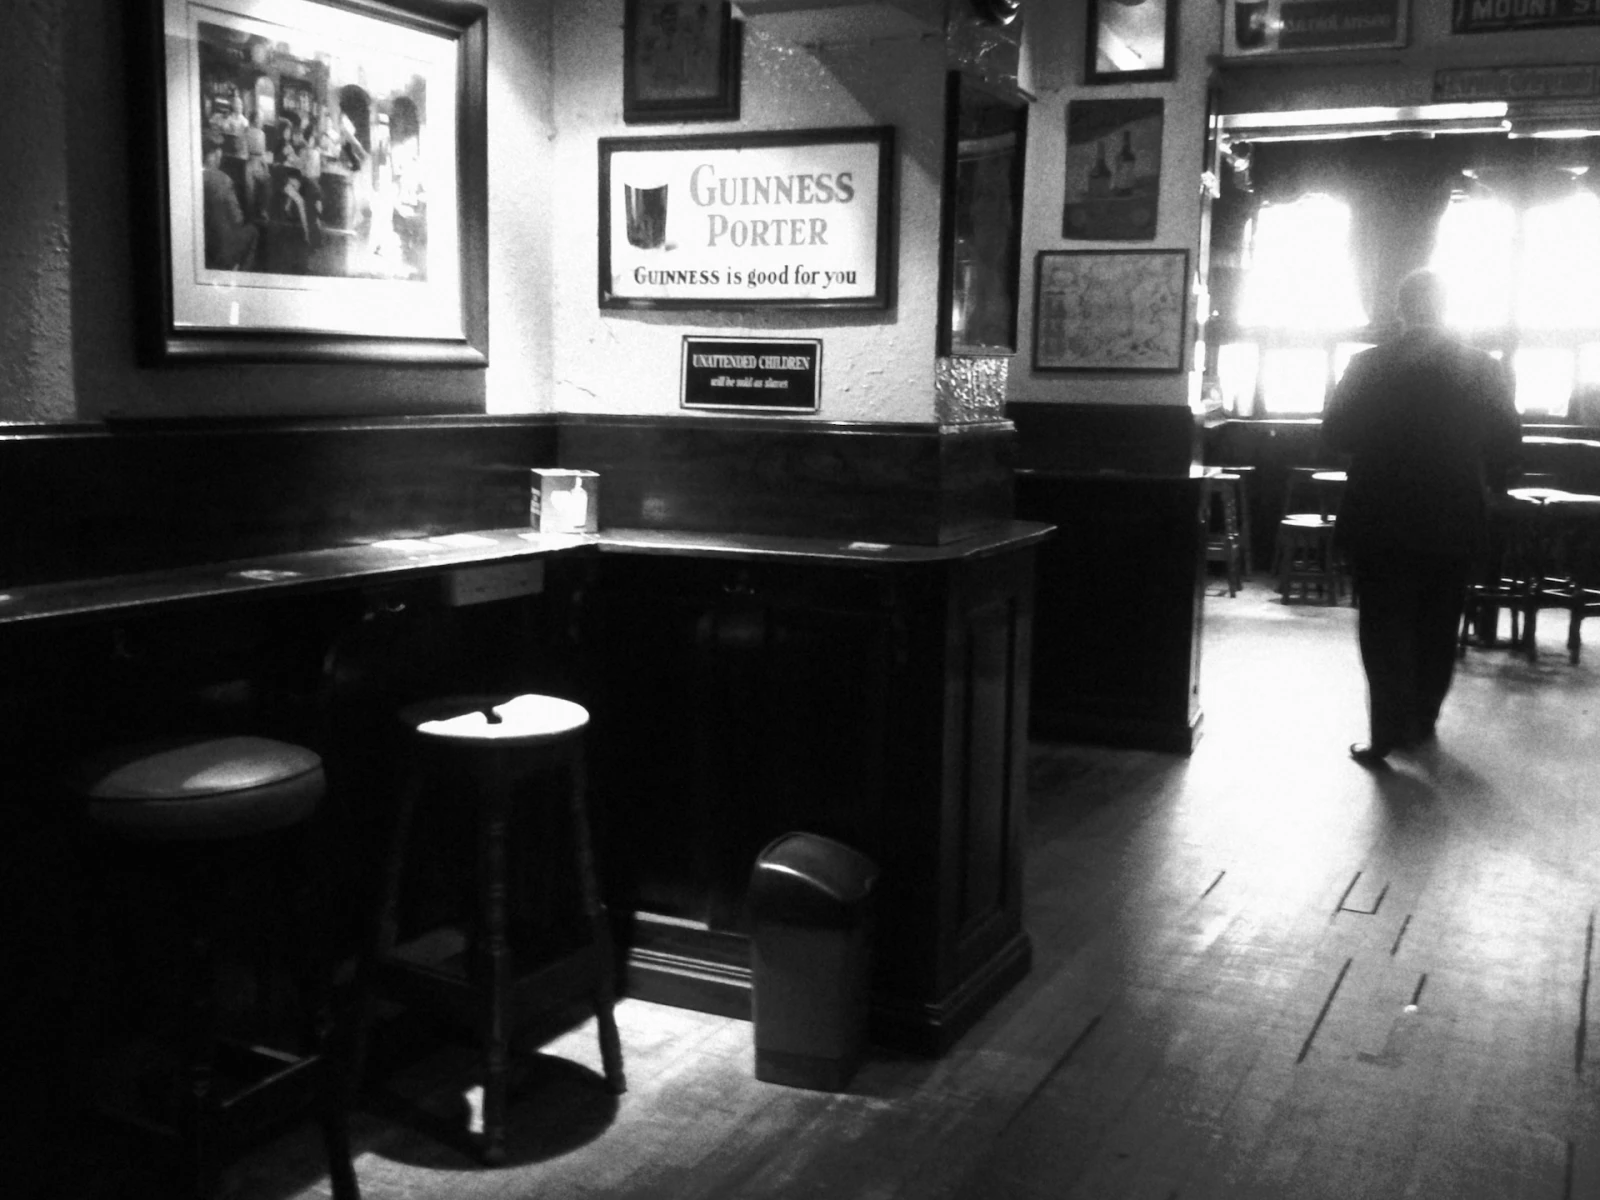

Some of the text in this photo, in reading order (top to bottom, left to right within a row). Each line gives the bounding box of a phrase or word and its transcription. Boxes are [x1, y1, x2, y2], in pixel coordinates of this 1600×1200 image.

[690, 163, 855, 206] GUINNESS
[707, 213, 828, 247] PORTER
[633, 265, 857, 289] GUINNESS is good for you
[692, 354, 811, 370] UNATTENDED CHILDREN
